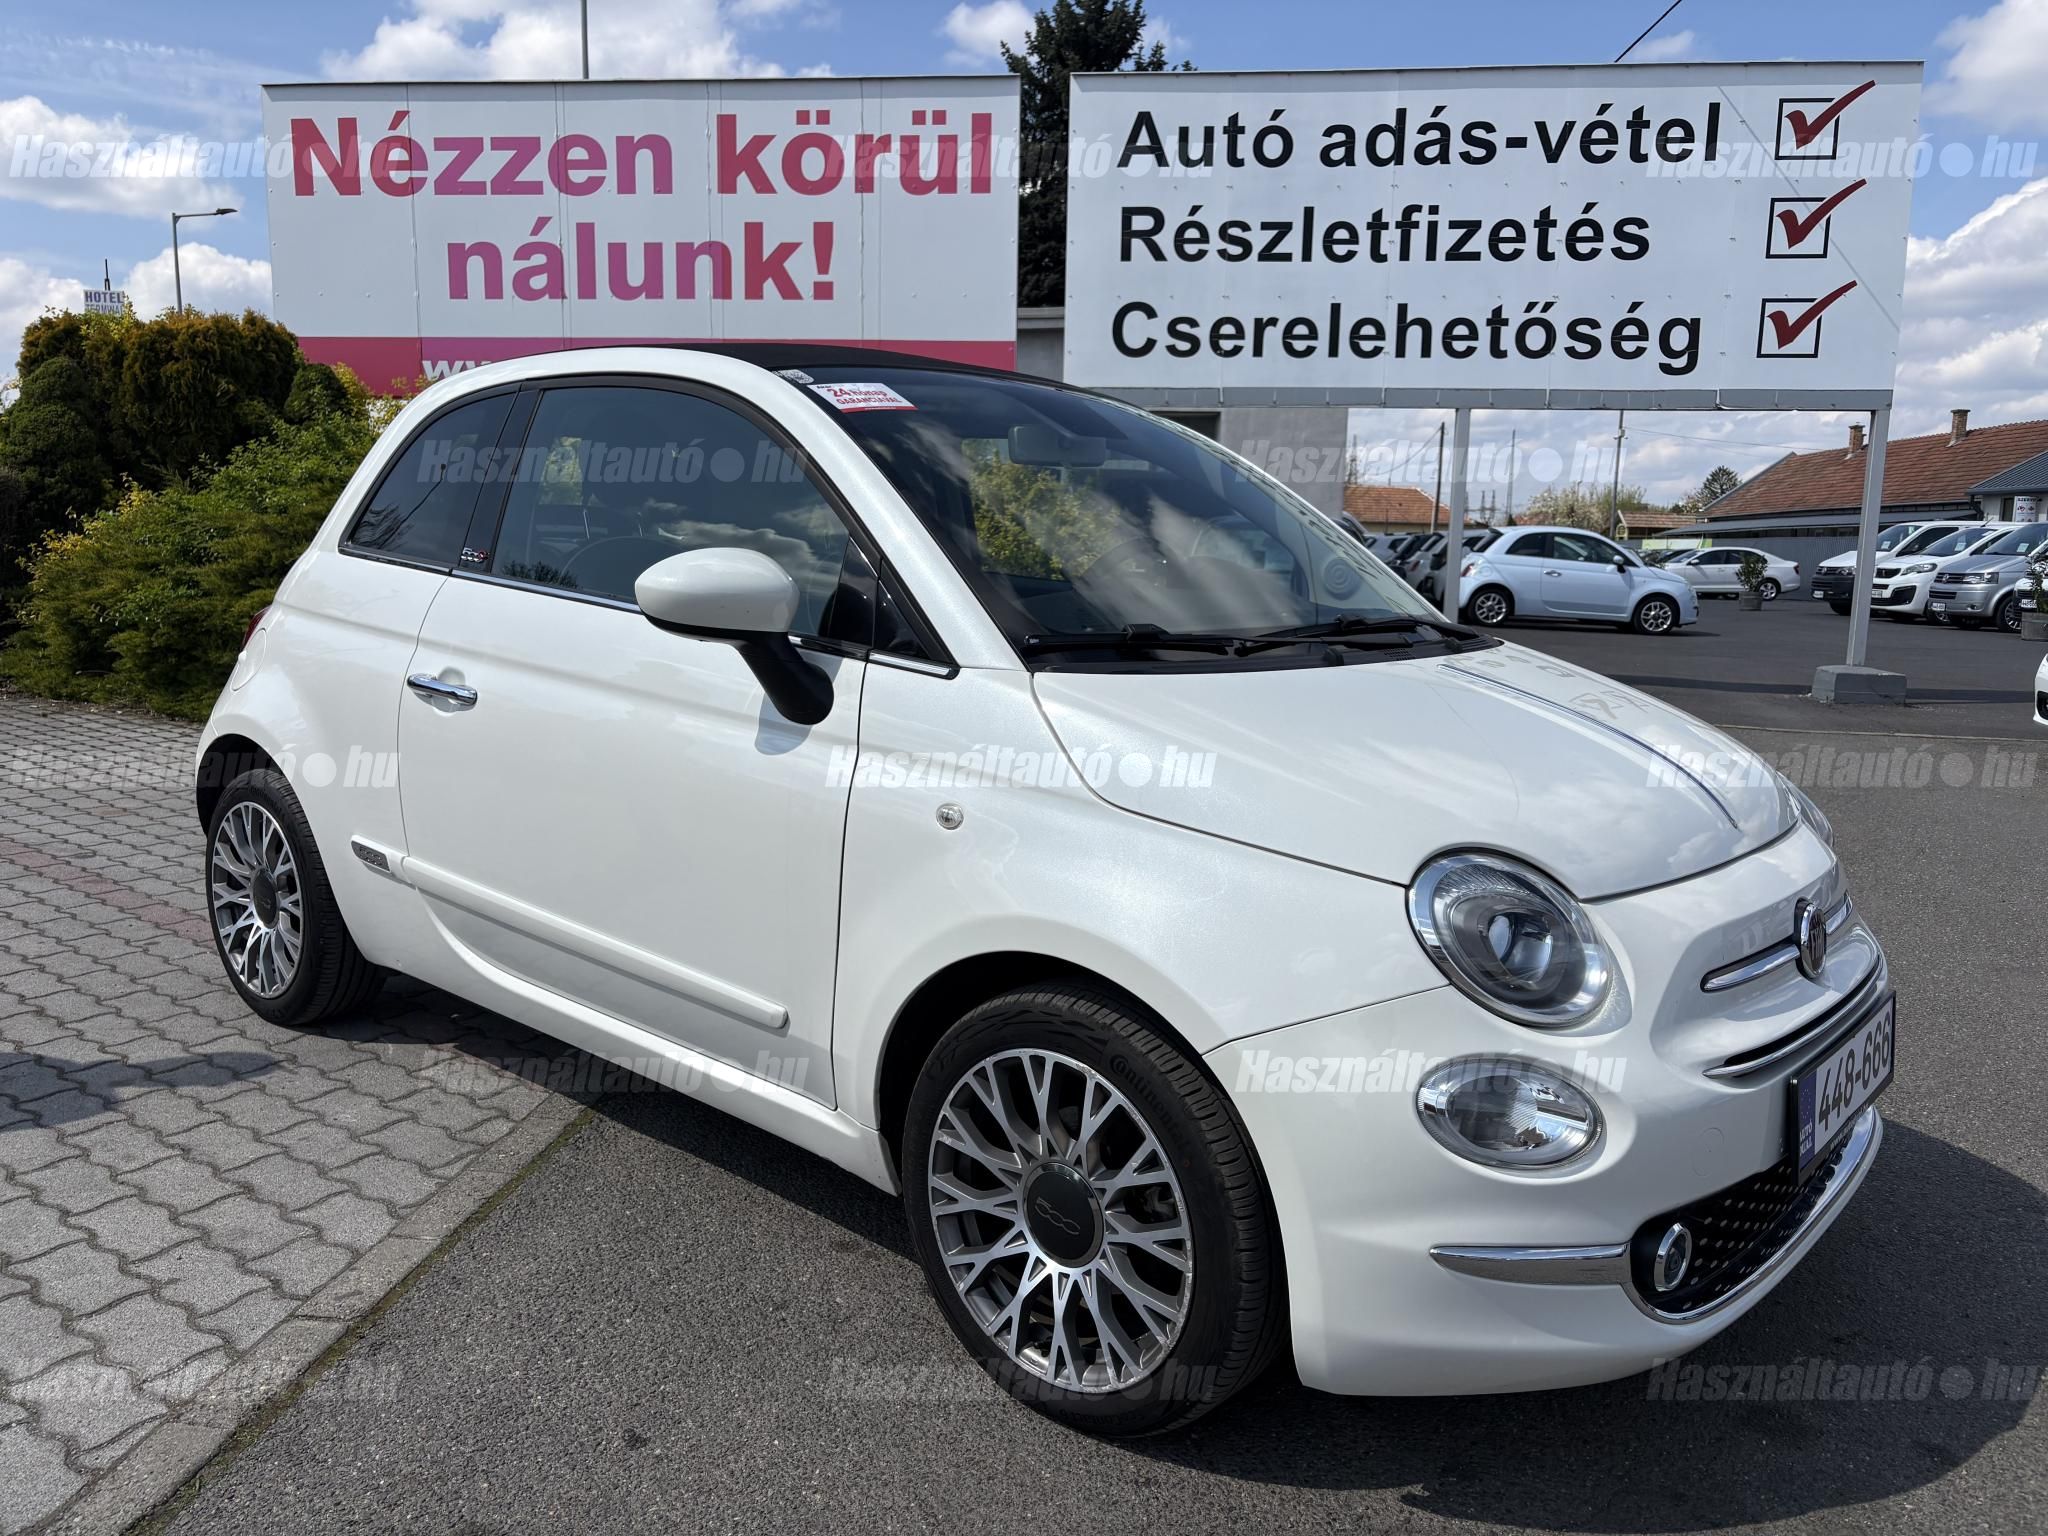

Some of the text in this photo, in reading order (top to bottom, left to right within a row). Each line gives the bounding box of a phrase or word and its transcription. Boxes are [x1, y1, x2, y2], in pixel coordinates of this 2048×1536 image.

[291, 111, 993, 197] Nézzen körül
[1116, 102, 1722, 169] Autó adás-vétel
[448, 217, 833, 300] nálunk!
[1120, 201, 1651, 263] Részletfizetés
[84, 291, 124, 304] HOTEL
[1112, 301, 1701, 377] Cserelehetőség
[827, 388, 850, 398] 24
[1818, 1015, 1892, 1132] 448-666
[1034, 1196, 1081, 1236] 500
